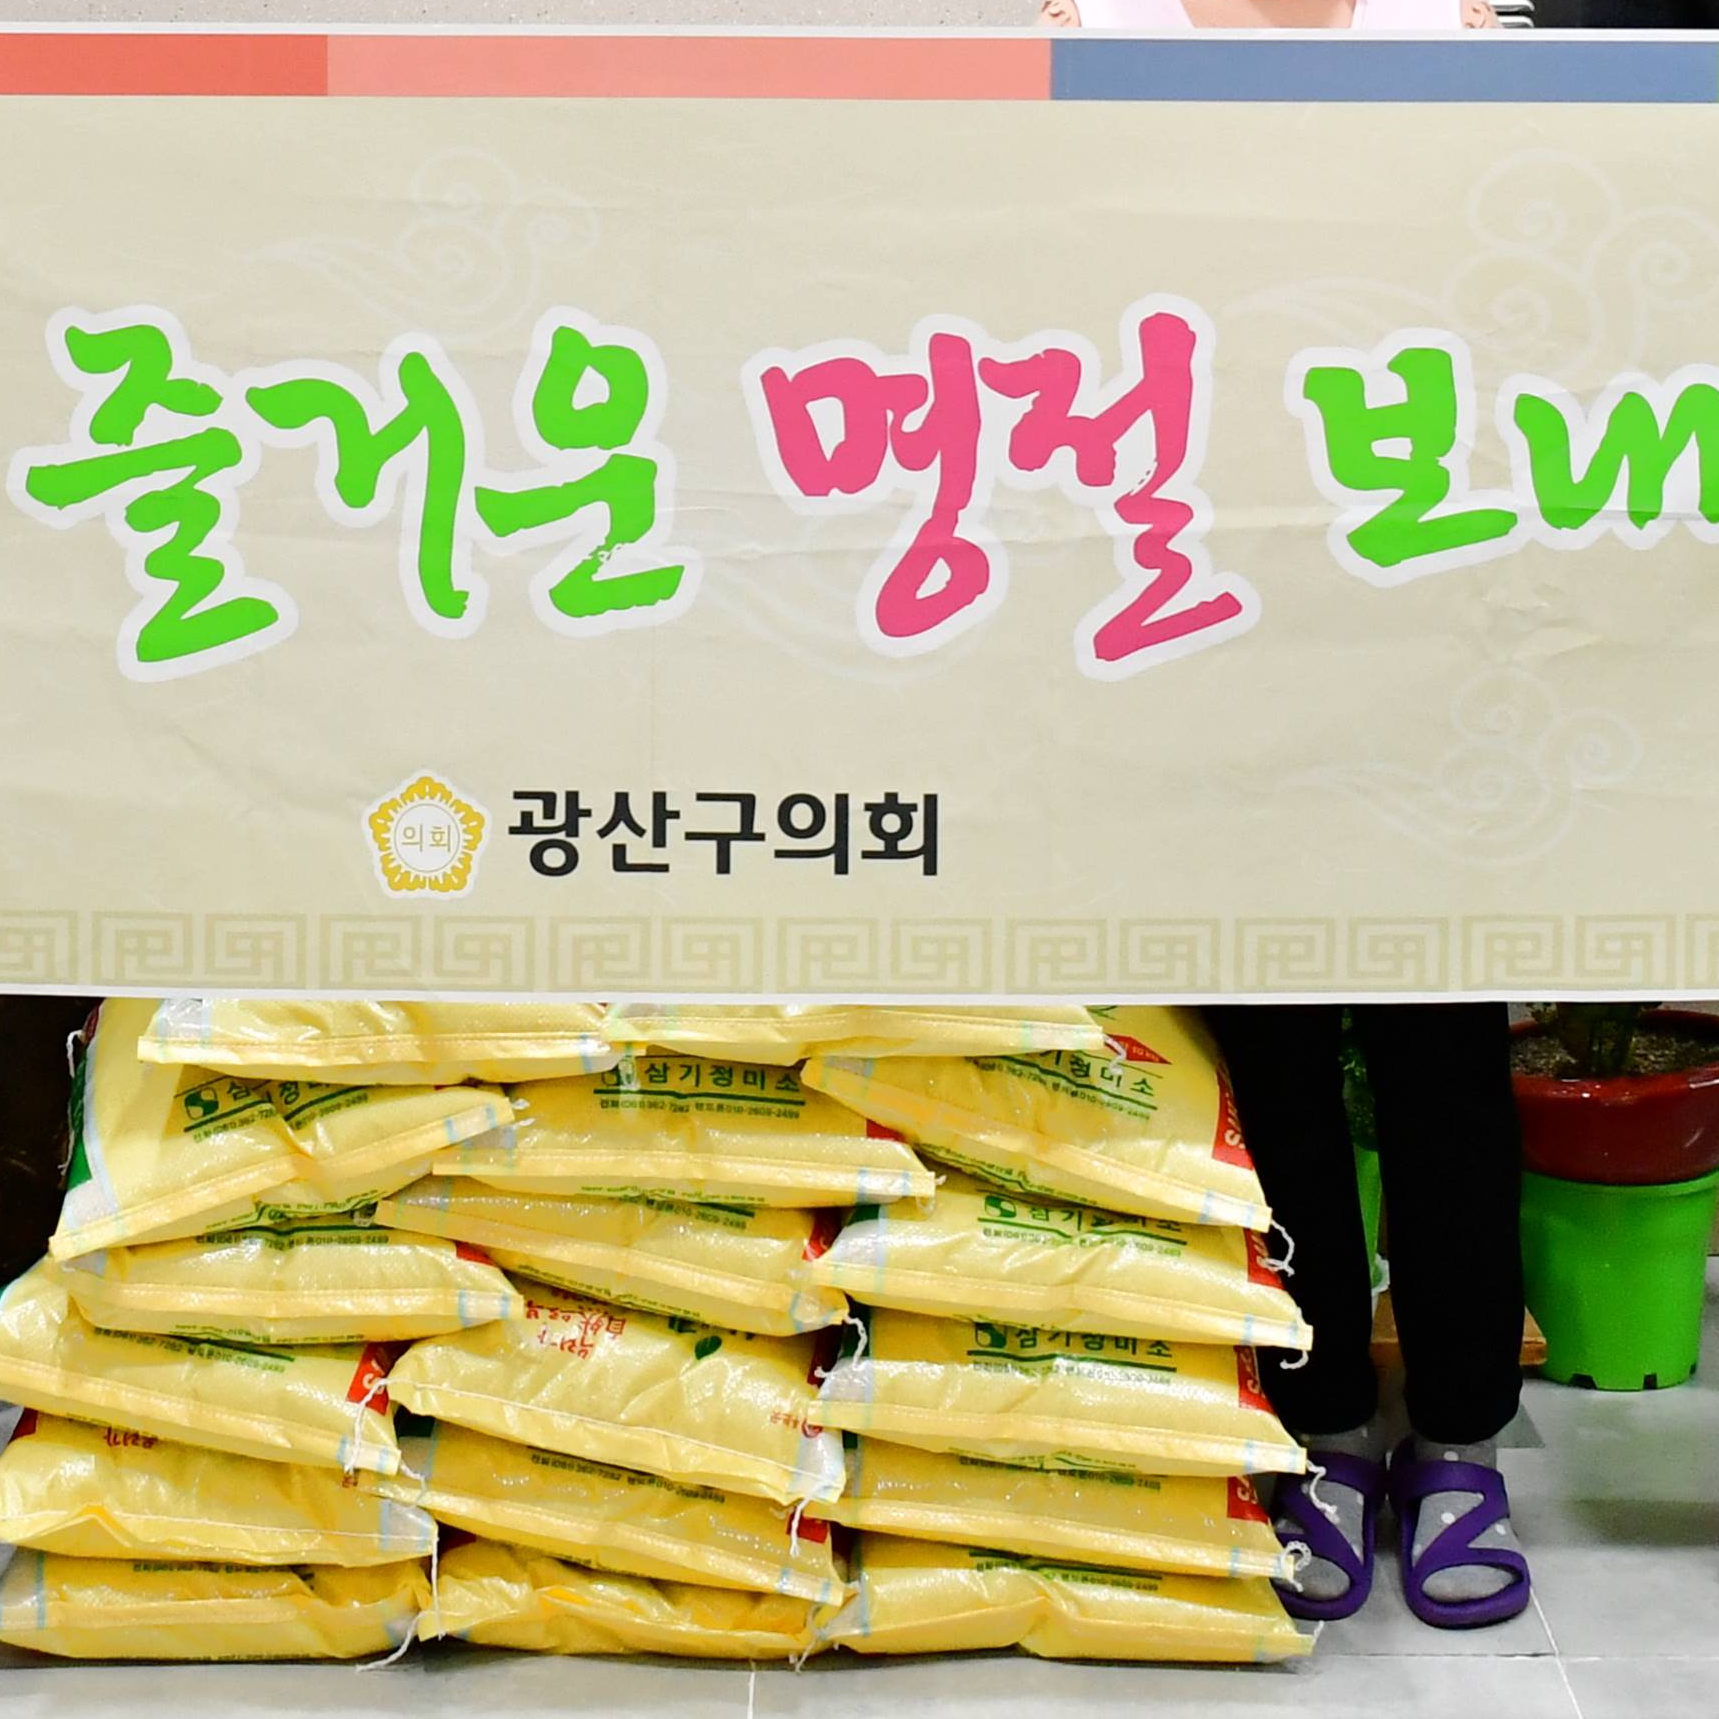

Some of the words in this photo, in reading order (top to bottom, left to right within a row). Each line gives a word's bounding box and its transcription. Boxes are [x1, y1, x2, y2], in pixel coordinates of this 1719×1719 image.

[26, 324, 689, 663] 즐거운
[763, 311, 1245, 664] 명절
[400, 822, 453, 855] 의회
[508, 790, 939, 876] 광산구의회
[645, 1061, 801, 1093] 삼기정미소
